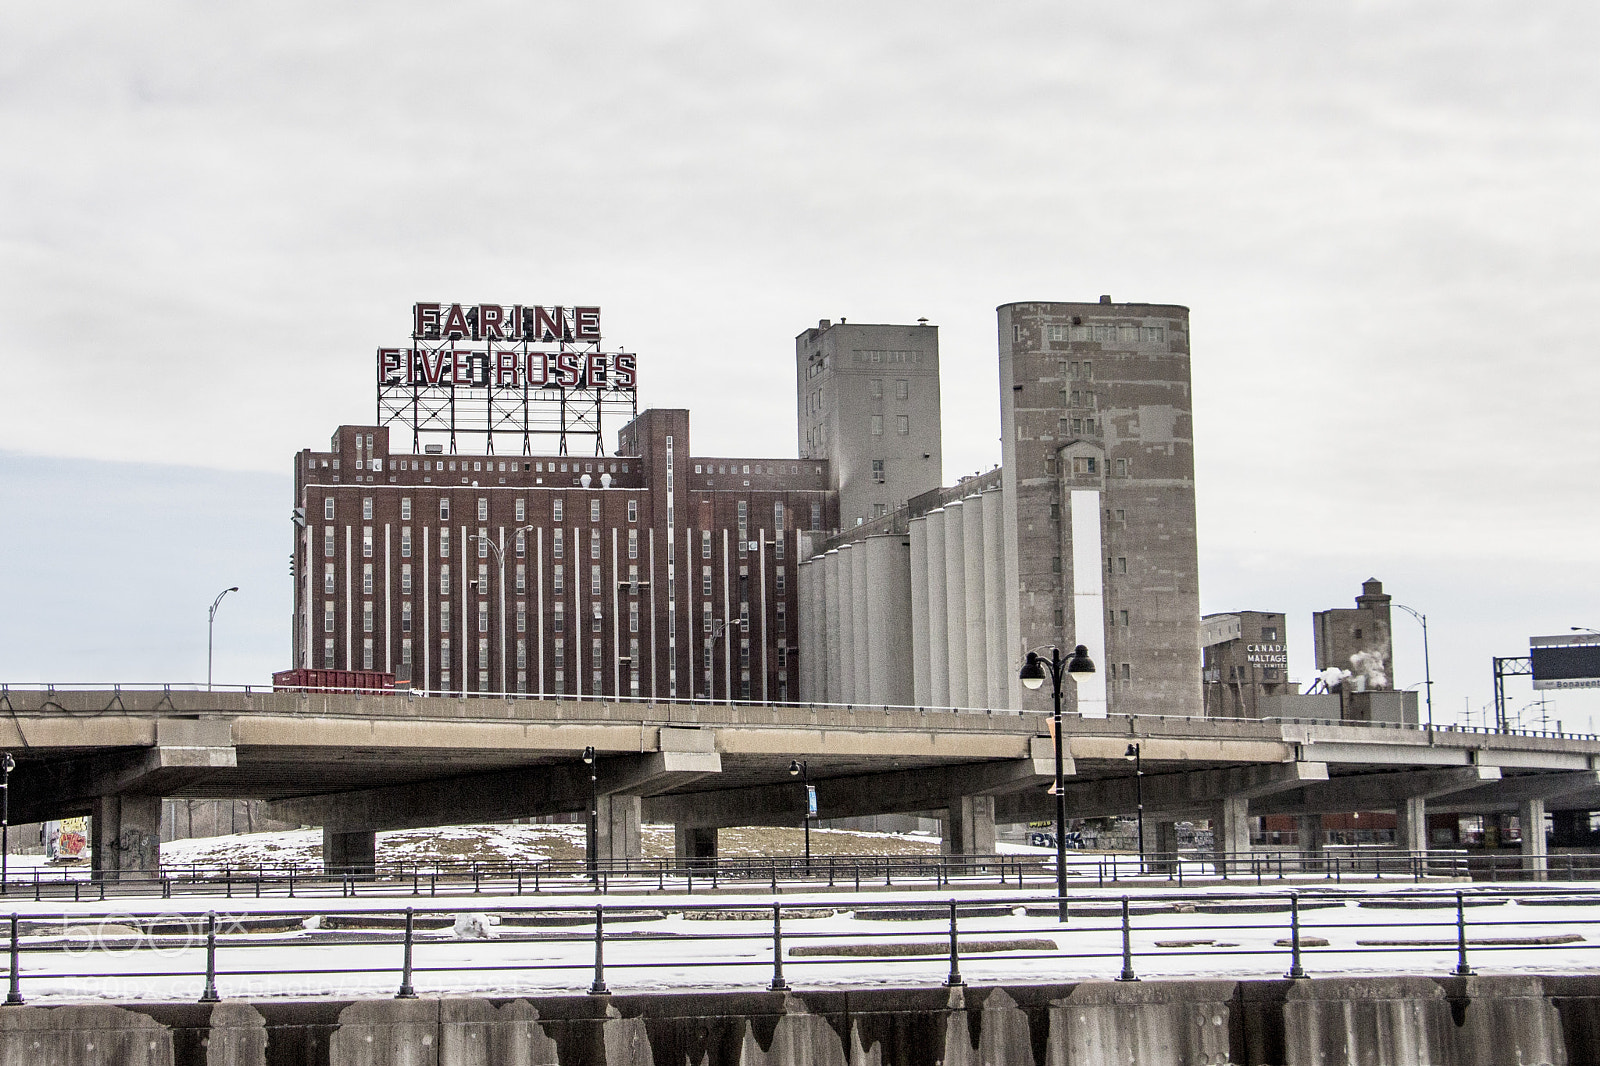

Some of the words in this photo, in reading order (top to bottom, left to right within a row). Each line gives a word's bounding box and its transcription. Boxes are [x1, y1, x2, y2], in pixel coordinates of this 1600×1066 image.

[414, 302, 601, 341] FARINE
[378, 348, 474, 386] FIVE
[496, 351, 637, 388] ROSES
[1246, 644, 1288, 652] CANADA
[1247, 654, 1287, 663] MALTAGE
